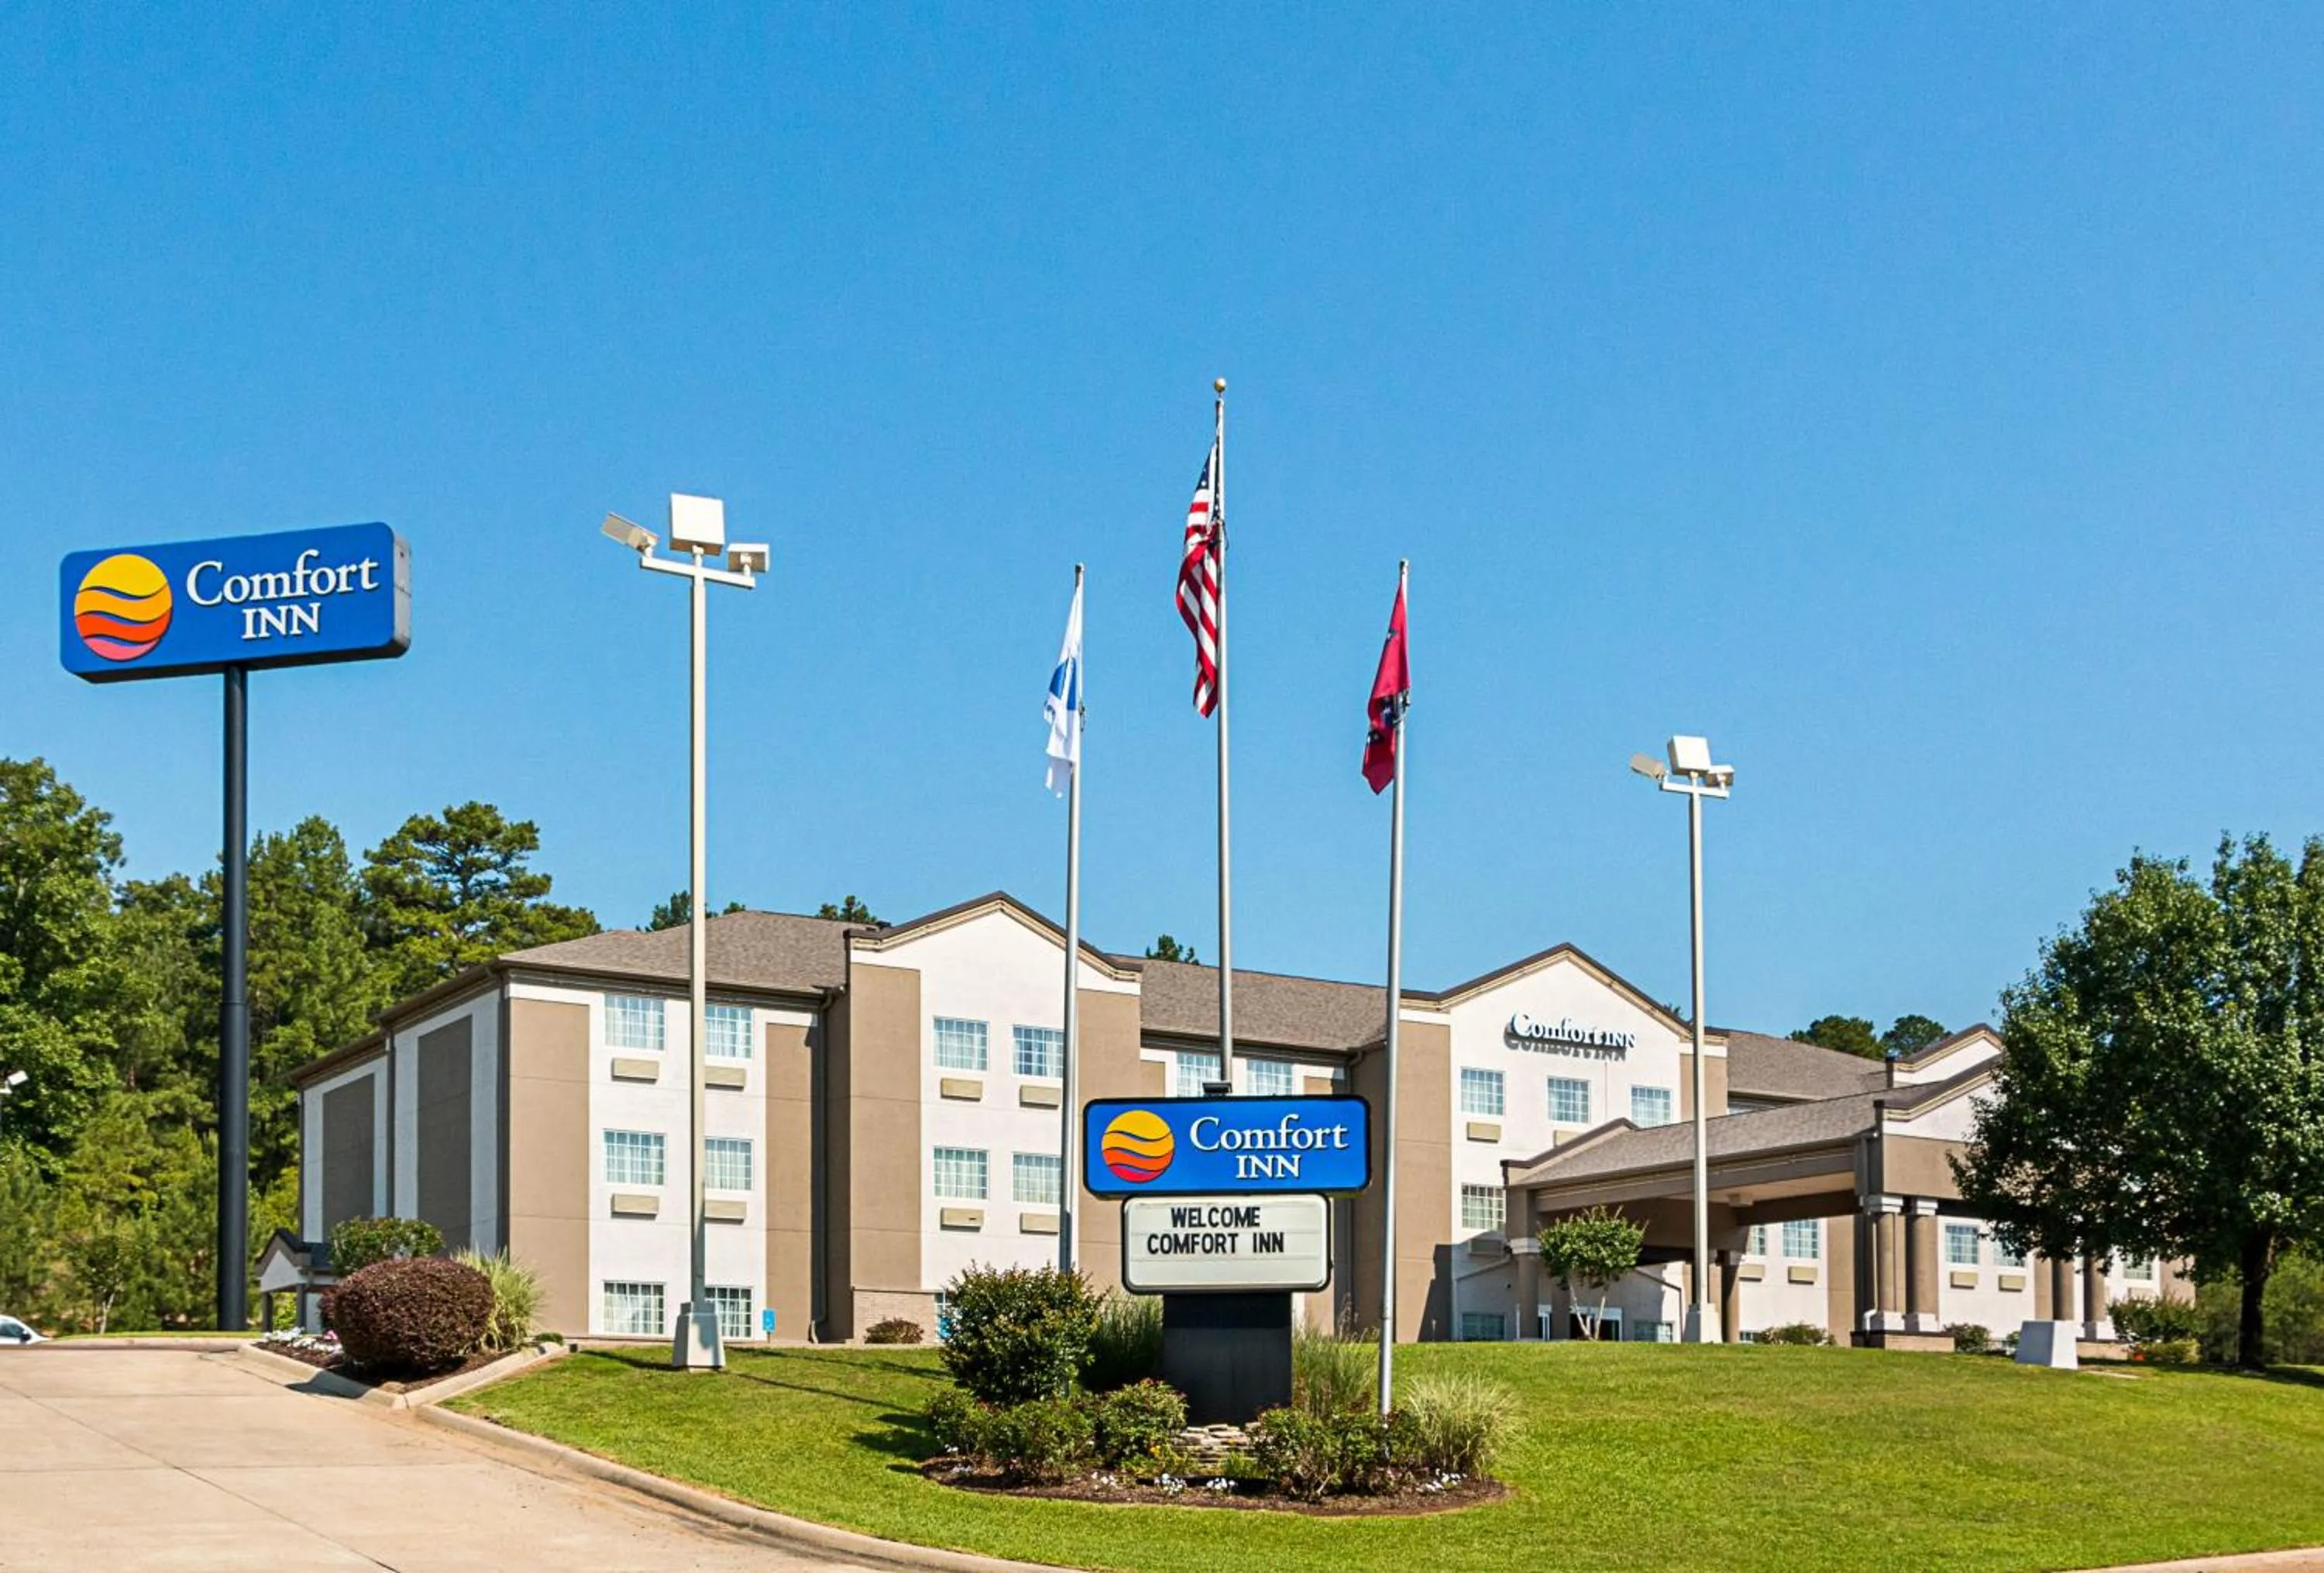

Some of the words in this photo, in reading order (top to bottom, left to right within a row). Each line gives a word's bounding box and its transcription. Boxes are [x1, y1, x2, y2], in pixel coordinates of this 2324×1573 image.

[186, 549, 380, 607] Comfort
[241, 602, 321, 641] INN
[1510, 1012, 1603, 1046] Comfort
[1605, 1030, 1637, 1048] INN
[1189, 1113, 1349, 1151] Comfort
[1236, 1154, 1301, 1179] INN
[1171, 1206, 1261, 1228] WELCOME
[1147, 1233, 1239, 1255] COMFORT
[1252, 1232, 1284, 1254] INN
